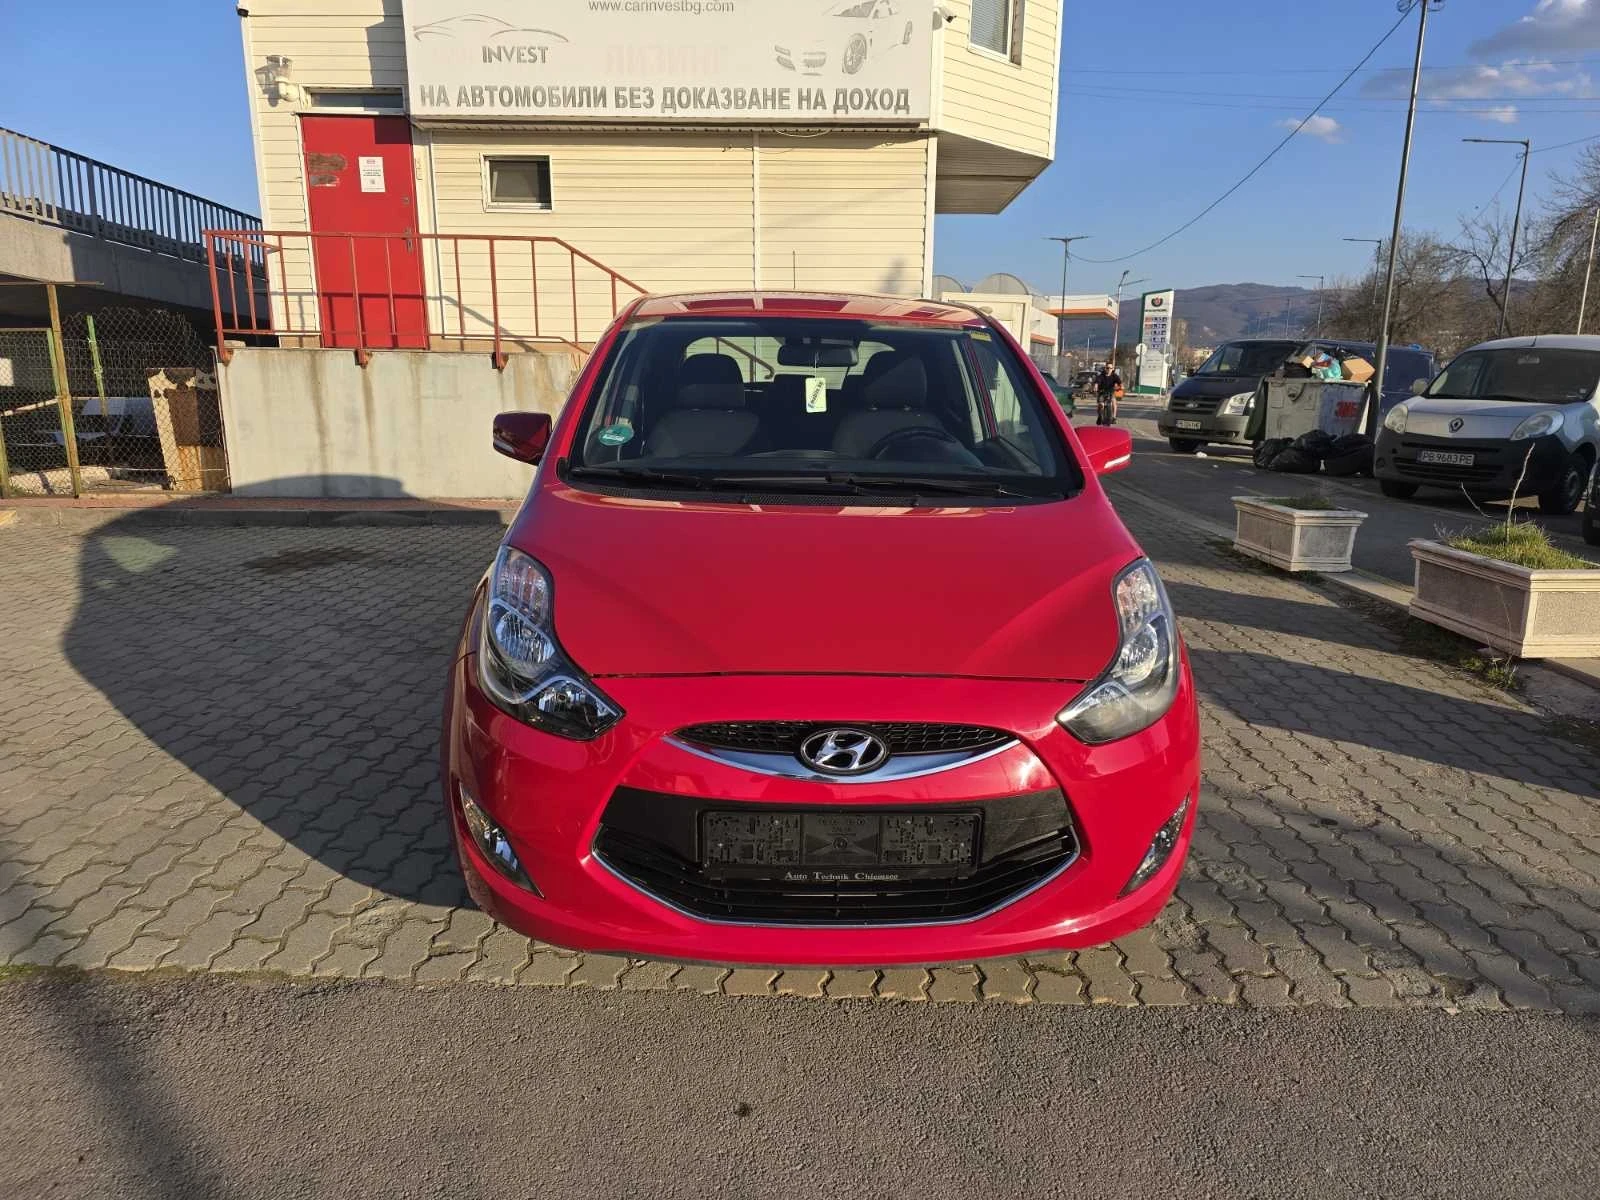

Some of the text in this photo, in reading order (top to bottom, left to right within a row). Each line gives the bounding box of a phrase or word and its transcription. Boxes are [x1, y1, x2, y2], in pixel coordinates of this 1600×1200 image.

[588, 0, 734, 15] www.carinvestbg.com
[482, 46, 548, 64] INVEST
[420, 85, 910, 115] НА АВТОМОБИЛИ БЕЗ ДОКАЗВАНЕ НА ДОХОД
[785, 872, 808, 880] Auto
[813, 871, 849, 880] Technik
